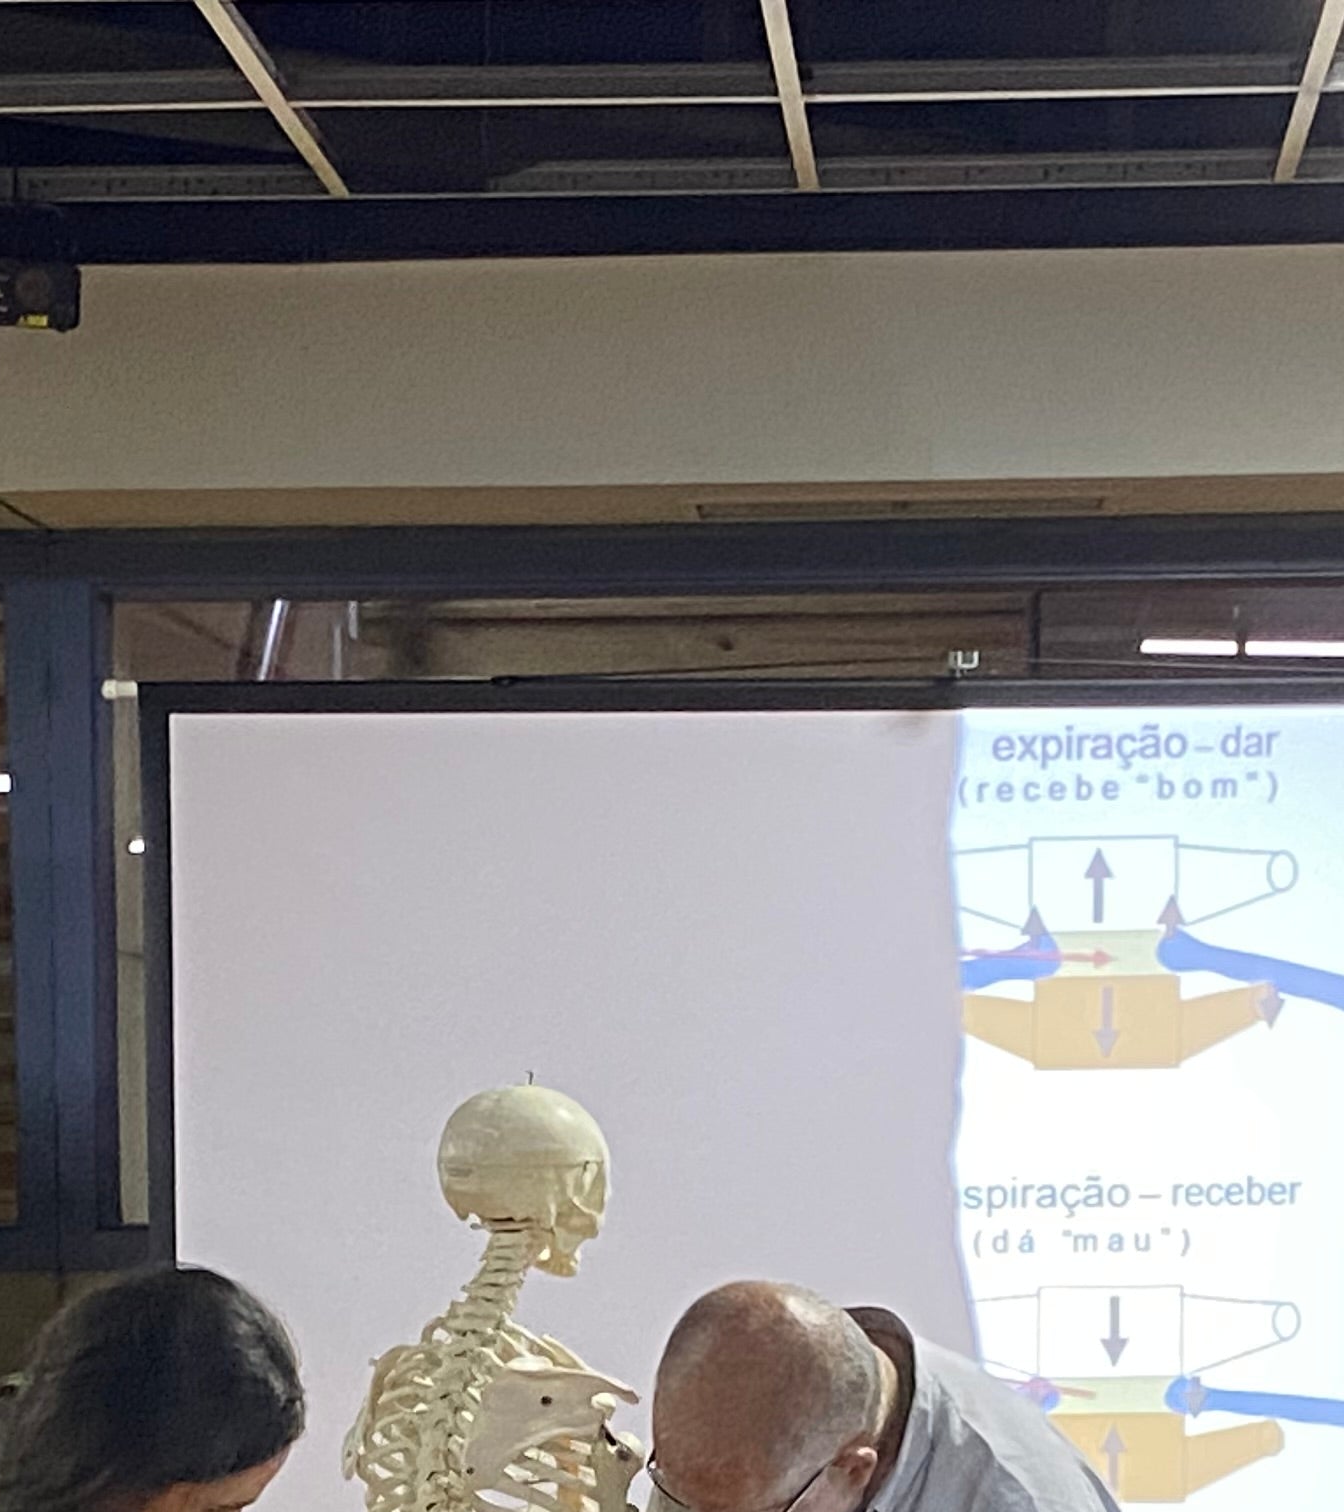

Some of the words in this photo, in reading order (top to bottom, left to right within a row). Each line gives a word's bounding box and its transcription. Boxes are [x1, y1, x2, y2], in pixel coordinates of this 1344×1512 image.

[991, 723, 1189, 770] expiração
[1219, 723, 1281, 759] dar
[1170, 1175, 1303, 1207] receber
